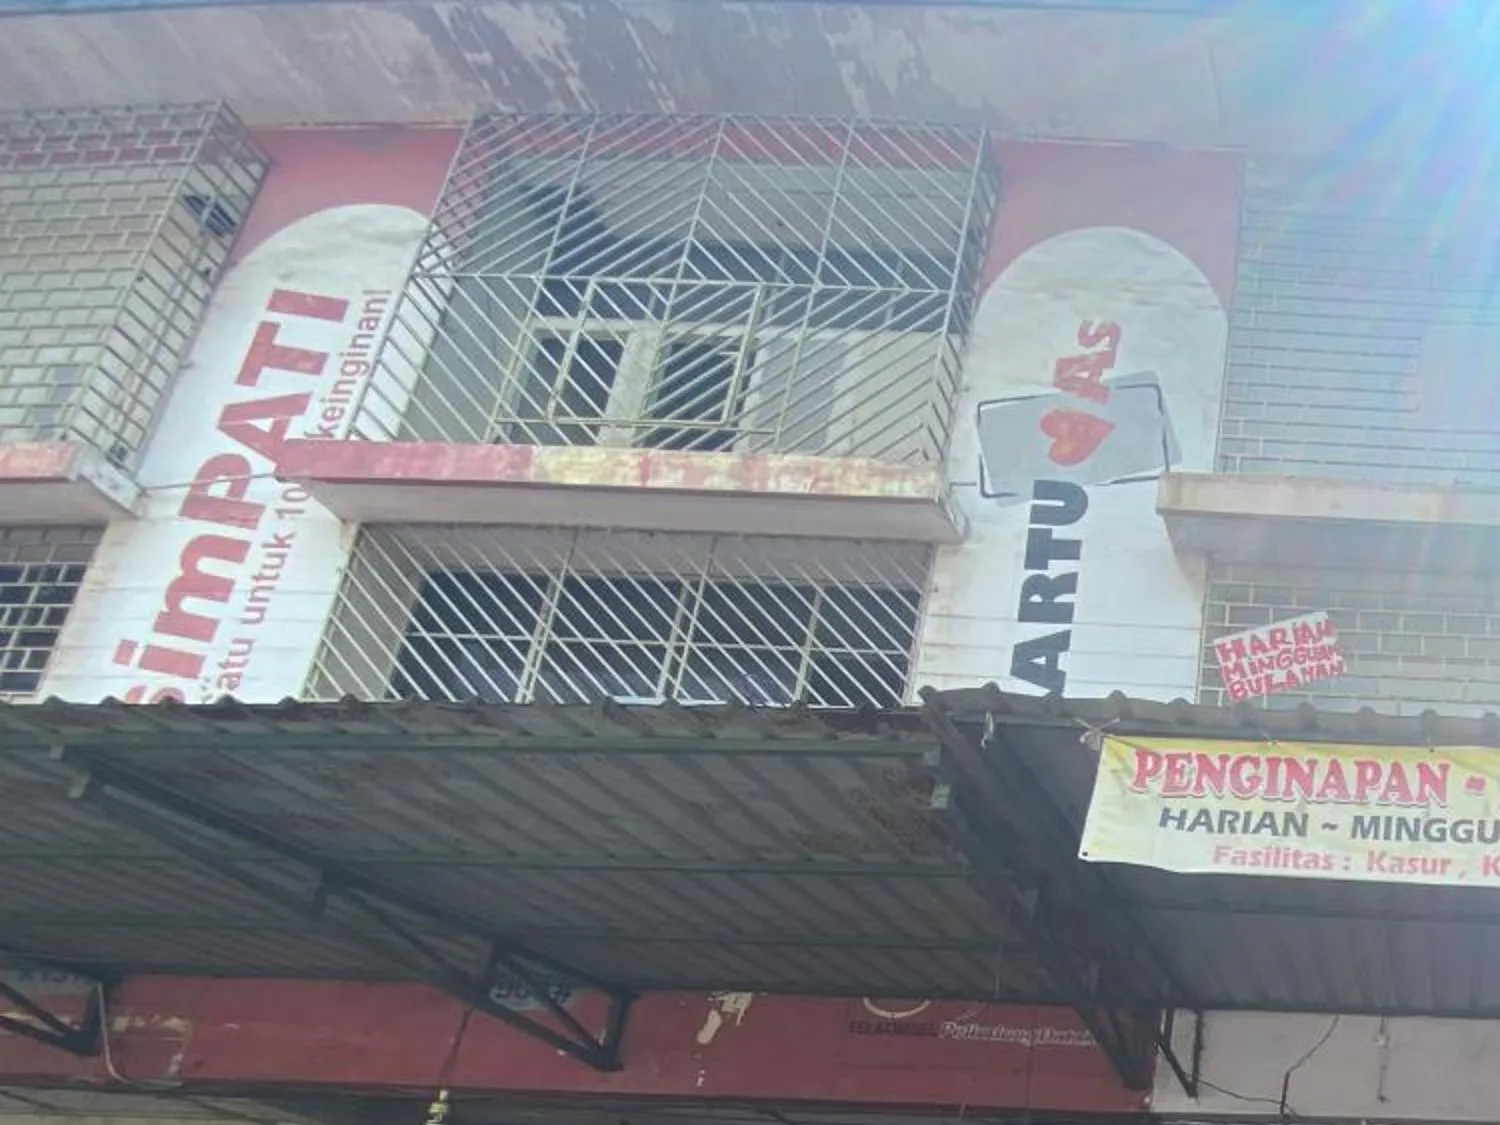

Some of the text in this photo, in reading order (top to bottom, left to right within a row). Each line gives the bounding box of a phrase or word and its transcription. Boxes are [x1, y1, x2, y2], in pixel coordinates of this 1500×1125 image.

[240, 531, 296, 627] untuk
[1130, 749, 1452, 806] PENGINAPAN
[1158, 806, 1309, 837] HARIAN
